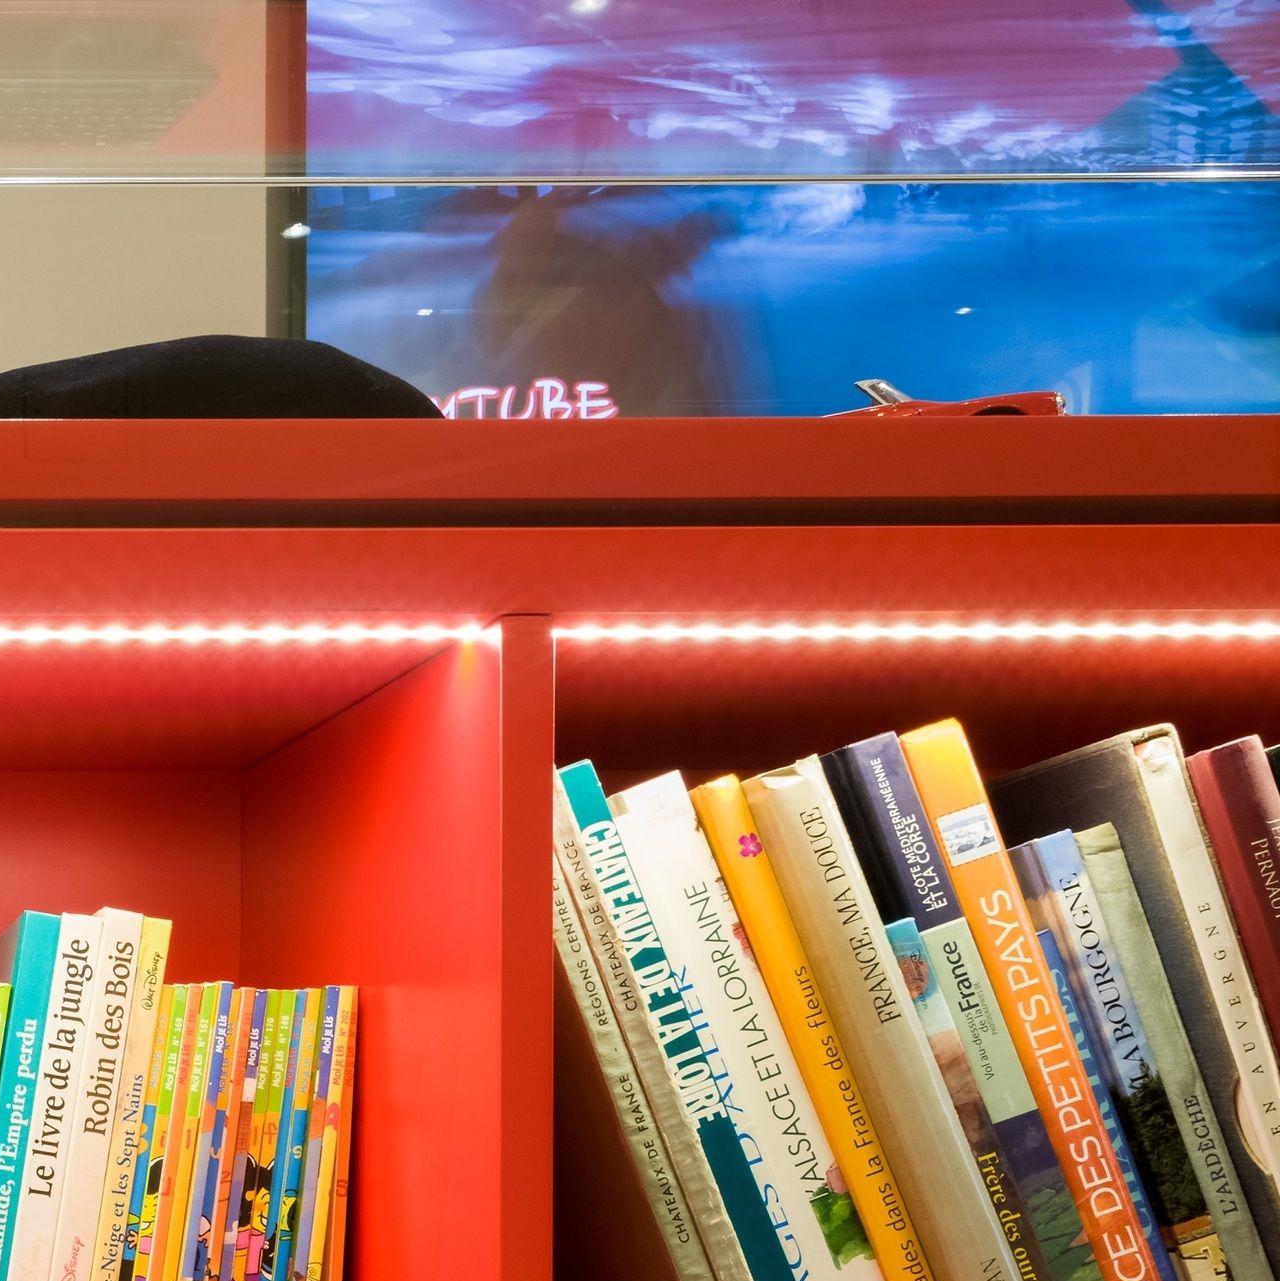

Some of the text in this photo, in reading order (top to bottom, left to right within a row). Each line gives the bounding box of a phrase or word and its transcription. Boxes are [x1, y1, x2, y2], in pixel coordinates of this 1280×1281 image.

[685, 878, 756, 1012] LORRAINE
[800, 804, 905, 1024] FRANCE, MA DOUCE
[980, 885, 1042, 991] PAYS
[574, 818, 729, 1128] CHATEAUX DE LA LOIRE
[789, 963, 831, 1030] fleurs
[13, 1016, 42, 1079] perdu
[84, 939, 136, 1136] Robin des Bois
[737, 1011, 769, 1047] LA
[815, 1032, 847, 1073] des
[1018, 990, 1094, 1132] PETITS
[30, 937, 96, 1198] Le livre de la jungle
[752, 1047, 783, 1081] ET
[126, 1072, 146, 1123] Nains
[832, 1075, 876, 1148] France
[119, 1128, 141, 1168] Sept
[861, 1152, 887, 1177] la
[1070, 1131, 1125, 1217] DES
[112, 1201, 127, 1217] et
[114, 1172, 131, 1195] les
[871, 1179, 910, 1235] dans
